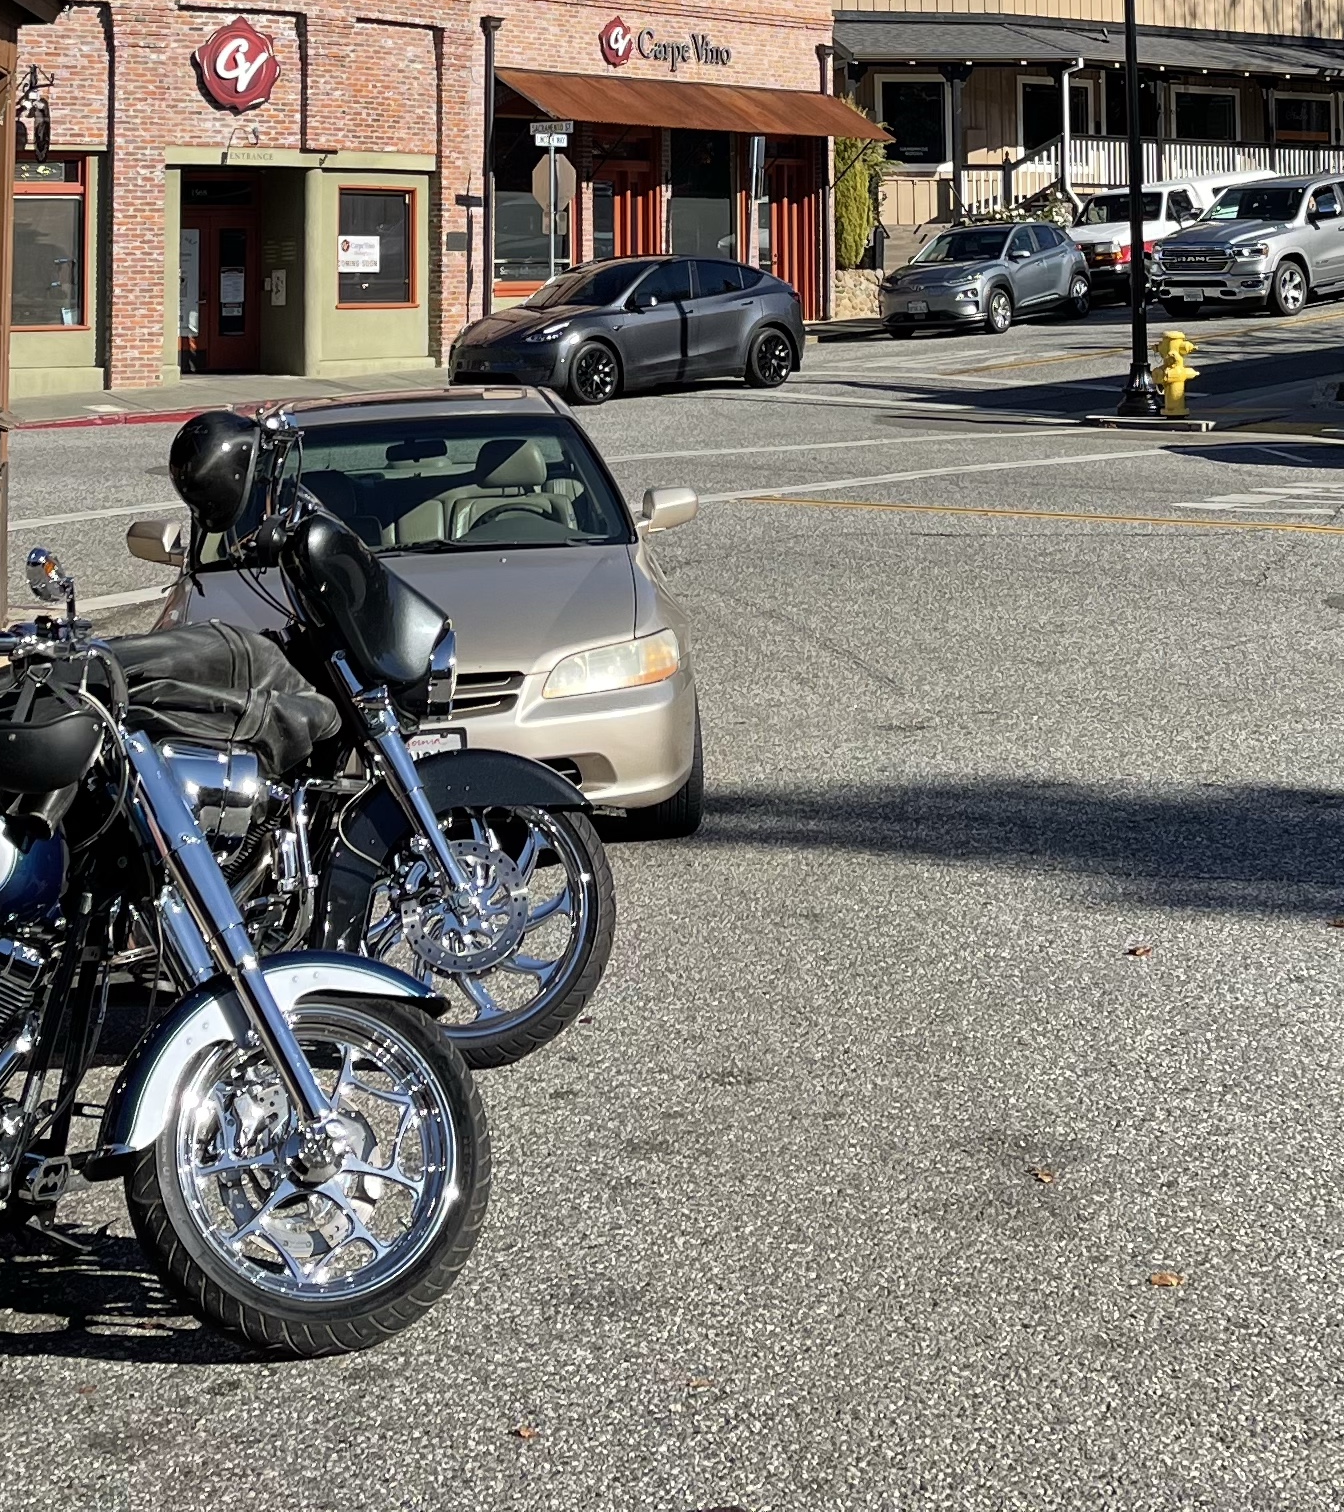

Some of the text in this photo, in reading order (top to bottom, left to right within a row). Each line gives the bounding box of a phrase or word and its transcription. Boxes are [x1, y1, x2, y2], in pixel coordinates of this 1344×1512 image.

[637, 27, 732, 72] Carpe Vino
[229, 152, 274, 161] ENTRANCE
